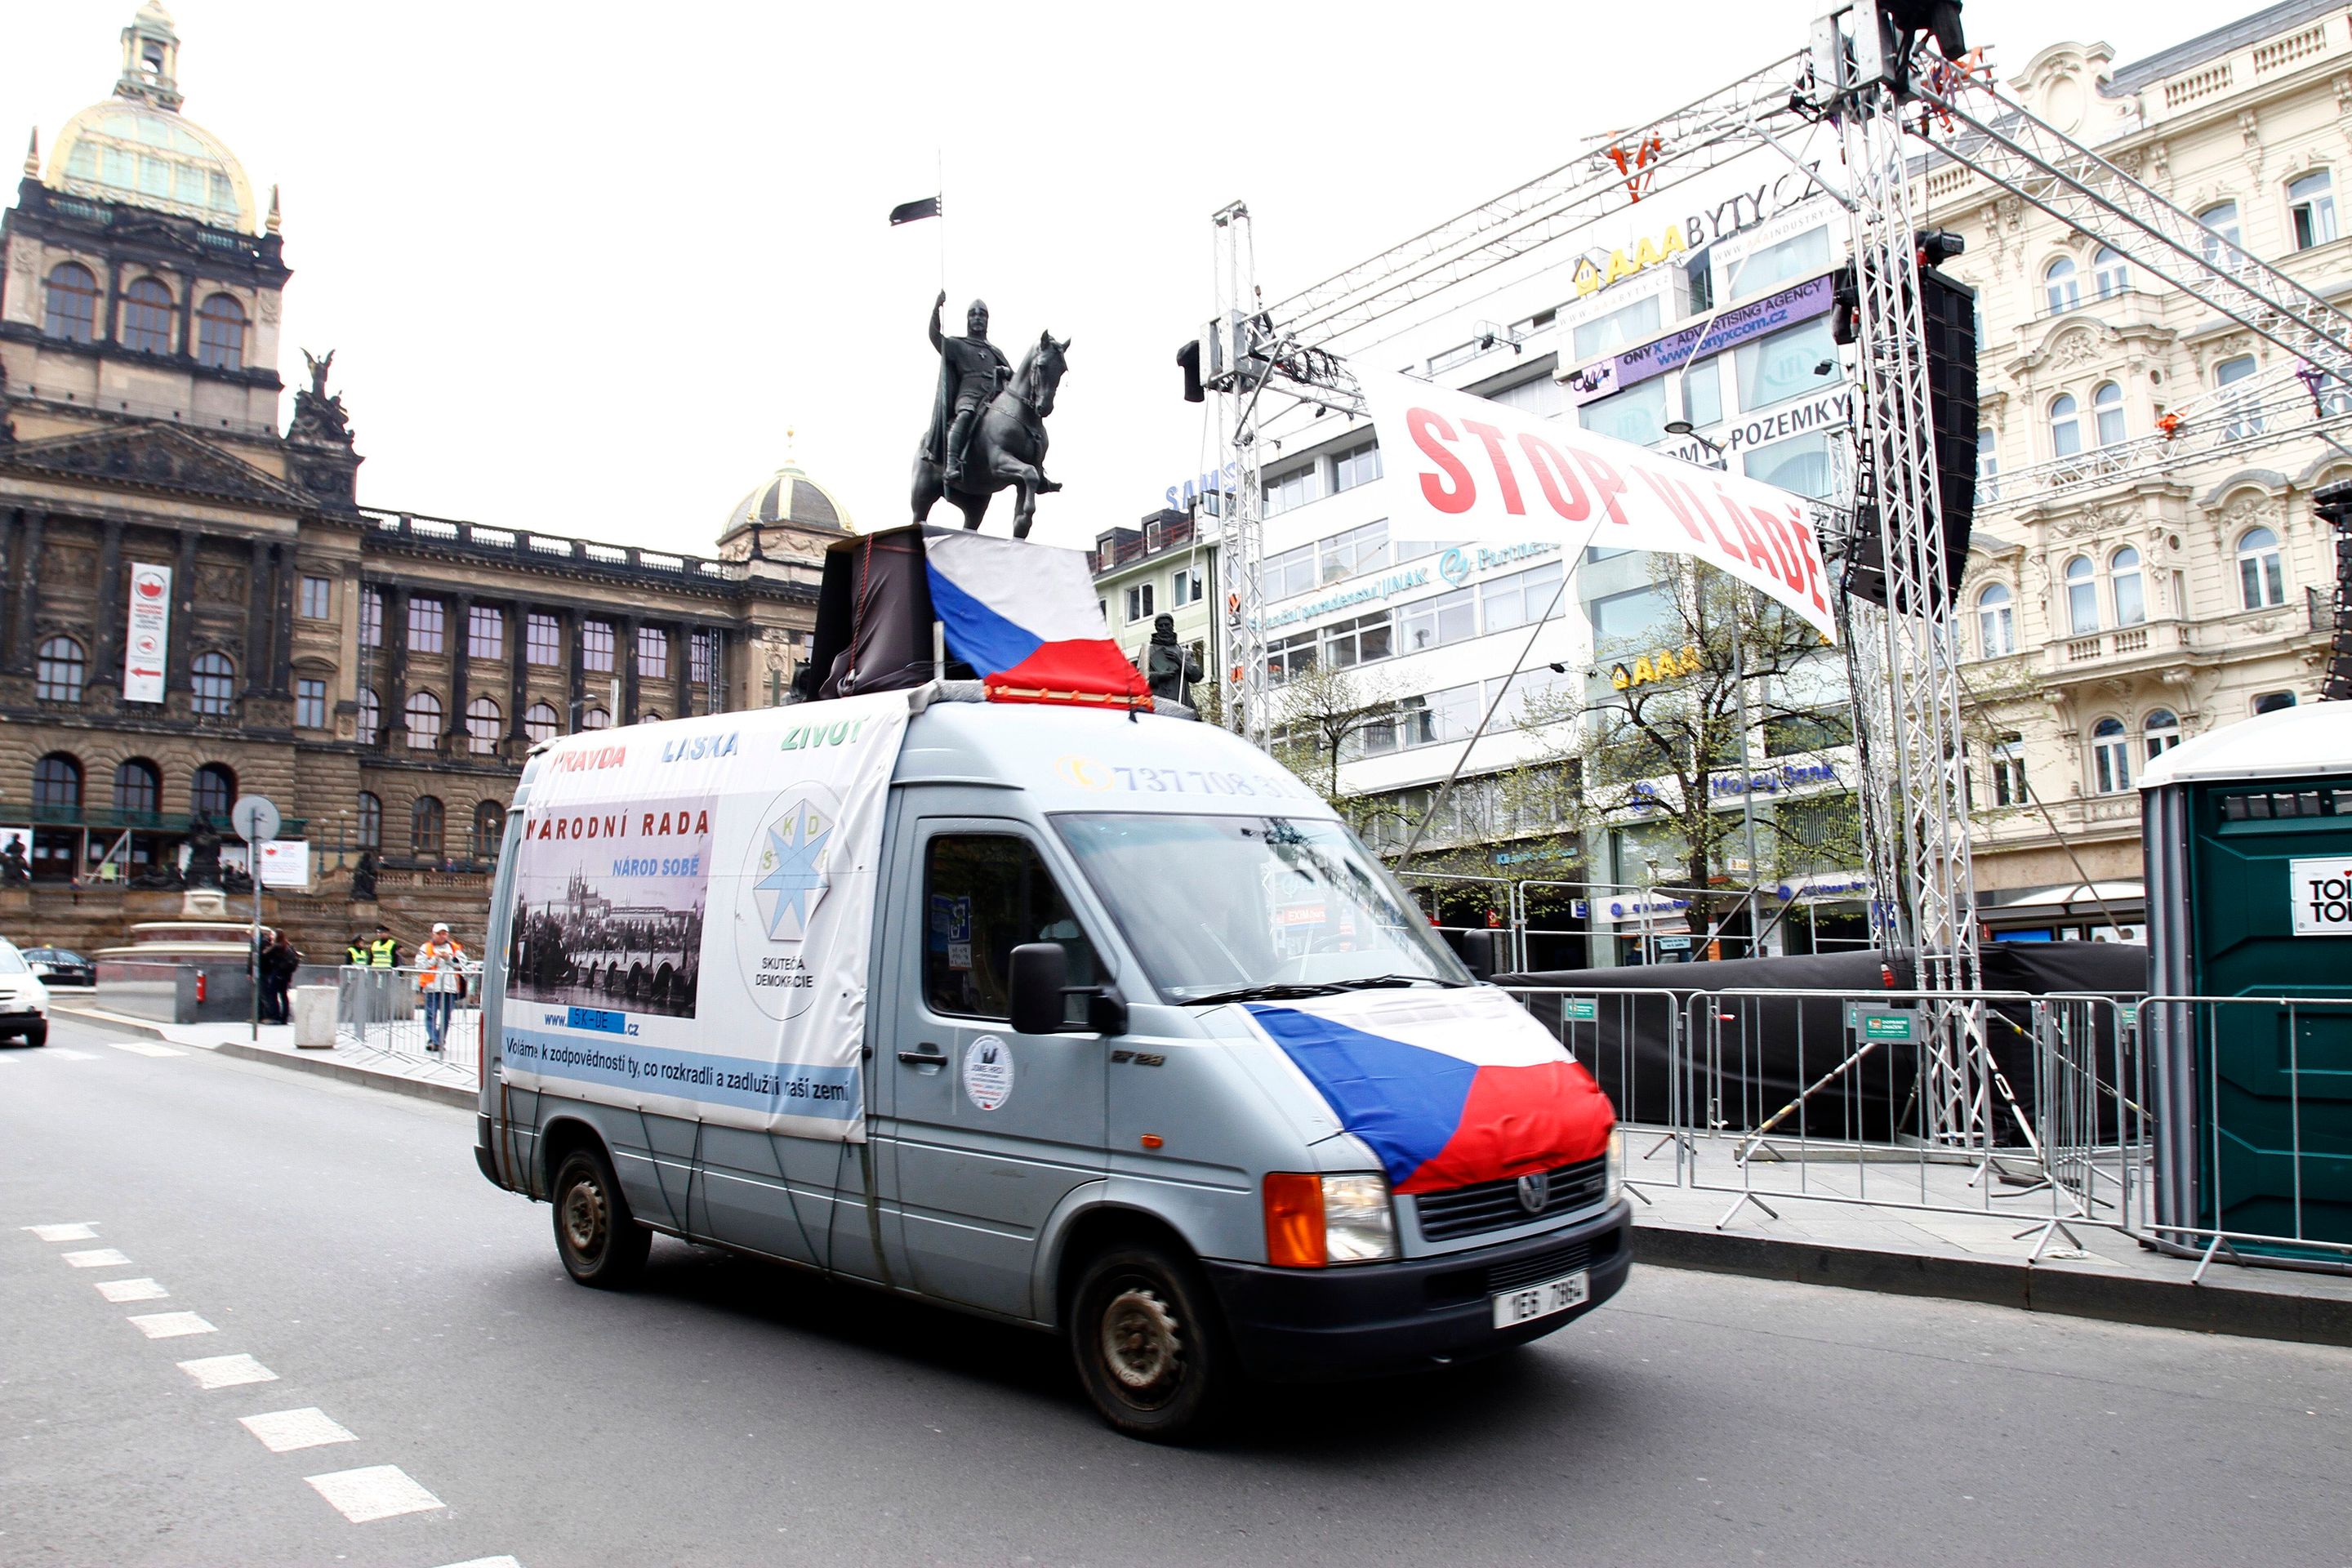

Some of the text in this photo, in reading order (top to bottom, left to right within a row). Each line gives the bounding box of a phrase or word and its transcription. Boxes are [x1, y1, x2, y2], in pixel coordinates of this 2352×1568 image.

[1623, 341, 1663, 367] ONYX
[1765, 278, 1824, 314] AGENCY
[1731, 392, 1849, 451] POZEMKY
[1405, 407, 1827, 616] STOP VLÁDĚ
[1112, 767, 1184, 793] 737
[525, 808, 710, 840] NÁRODNÍ RADA
[612, 853, 700, 877] NÁROD SOBĚ
[755, 973, 814, 988] DEMOKRCIE
[541, 1043, 549, 1062] k
[550, 1046, 626, 1074] zodpovědnosti
[628, 1056, 641, 1079] ty,
[644, 1062, 658, 1077] co
[661, 1062, 714, 1086] rozkradli
[715, 1071, 724, 1087] a
